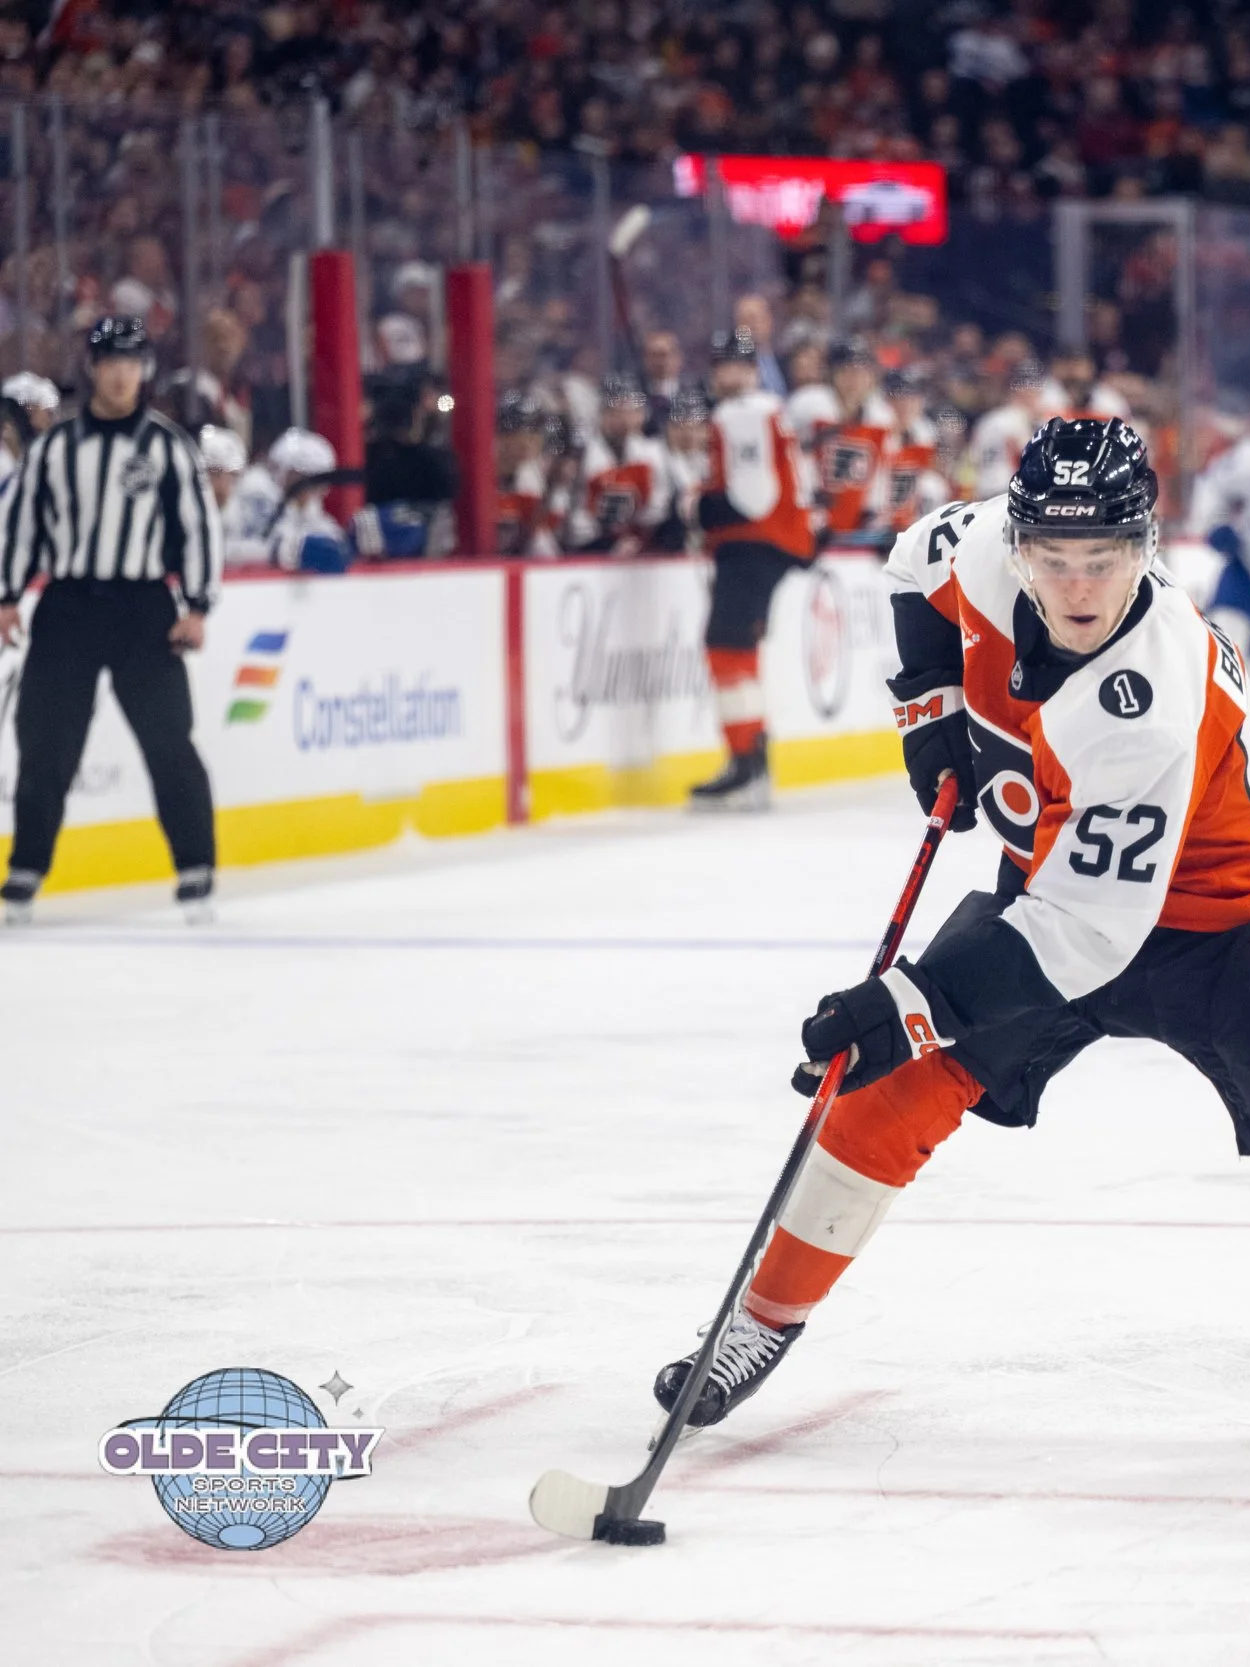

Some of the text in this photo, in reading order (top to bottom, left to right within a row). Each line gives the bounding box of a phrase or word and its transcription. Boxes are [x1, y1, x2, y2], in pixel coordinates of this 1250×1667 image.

[1053, 460, 1090, 486] 52
[1044, 505, 1096, 517] CCM
[1113, 673, 1140, 714] 1
[1068, 803, 1168, 883] 52
